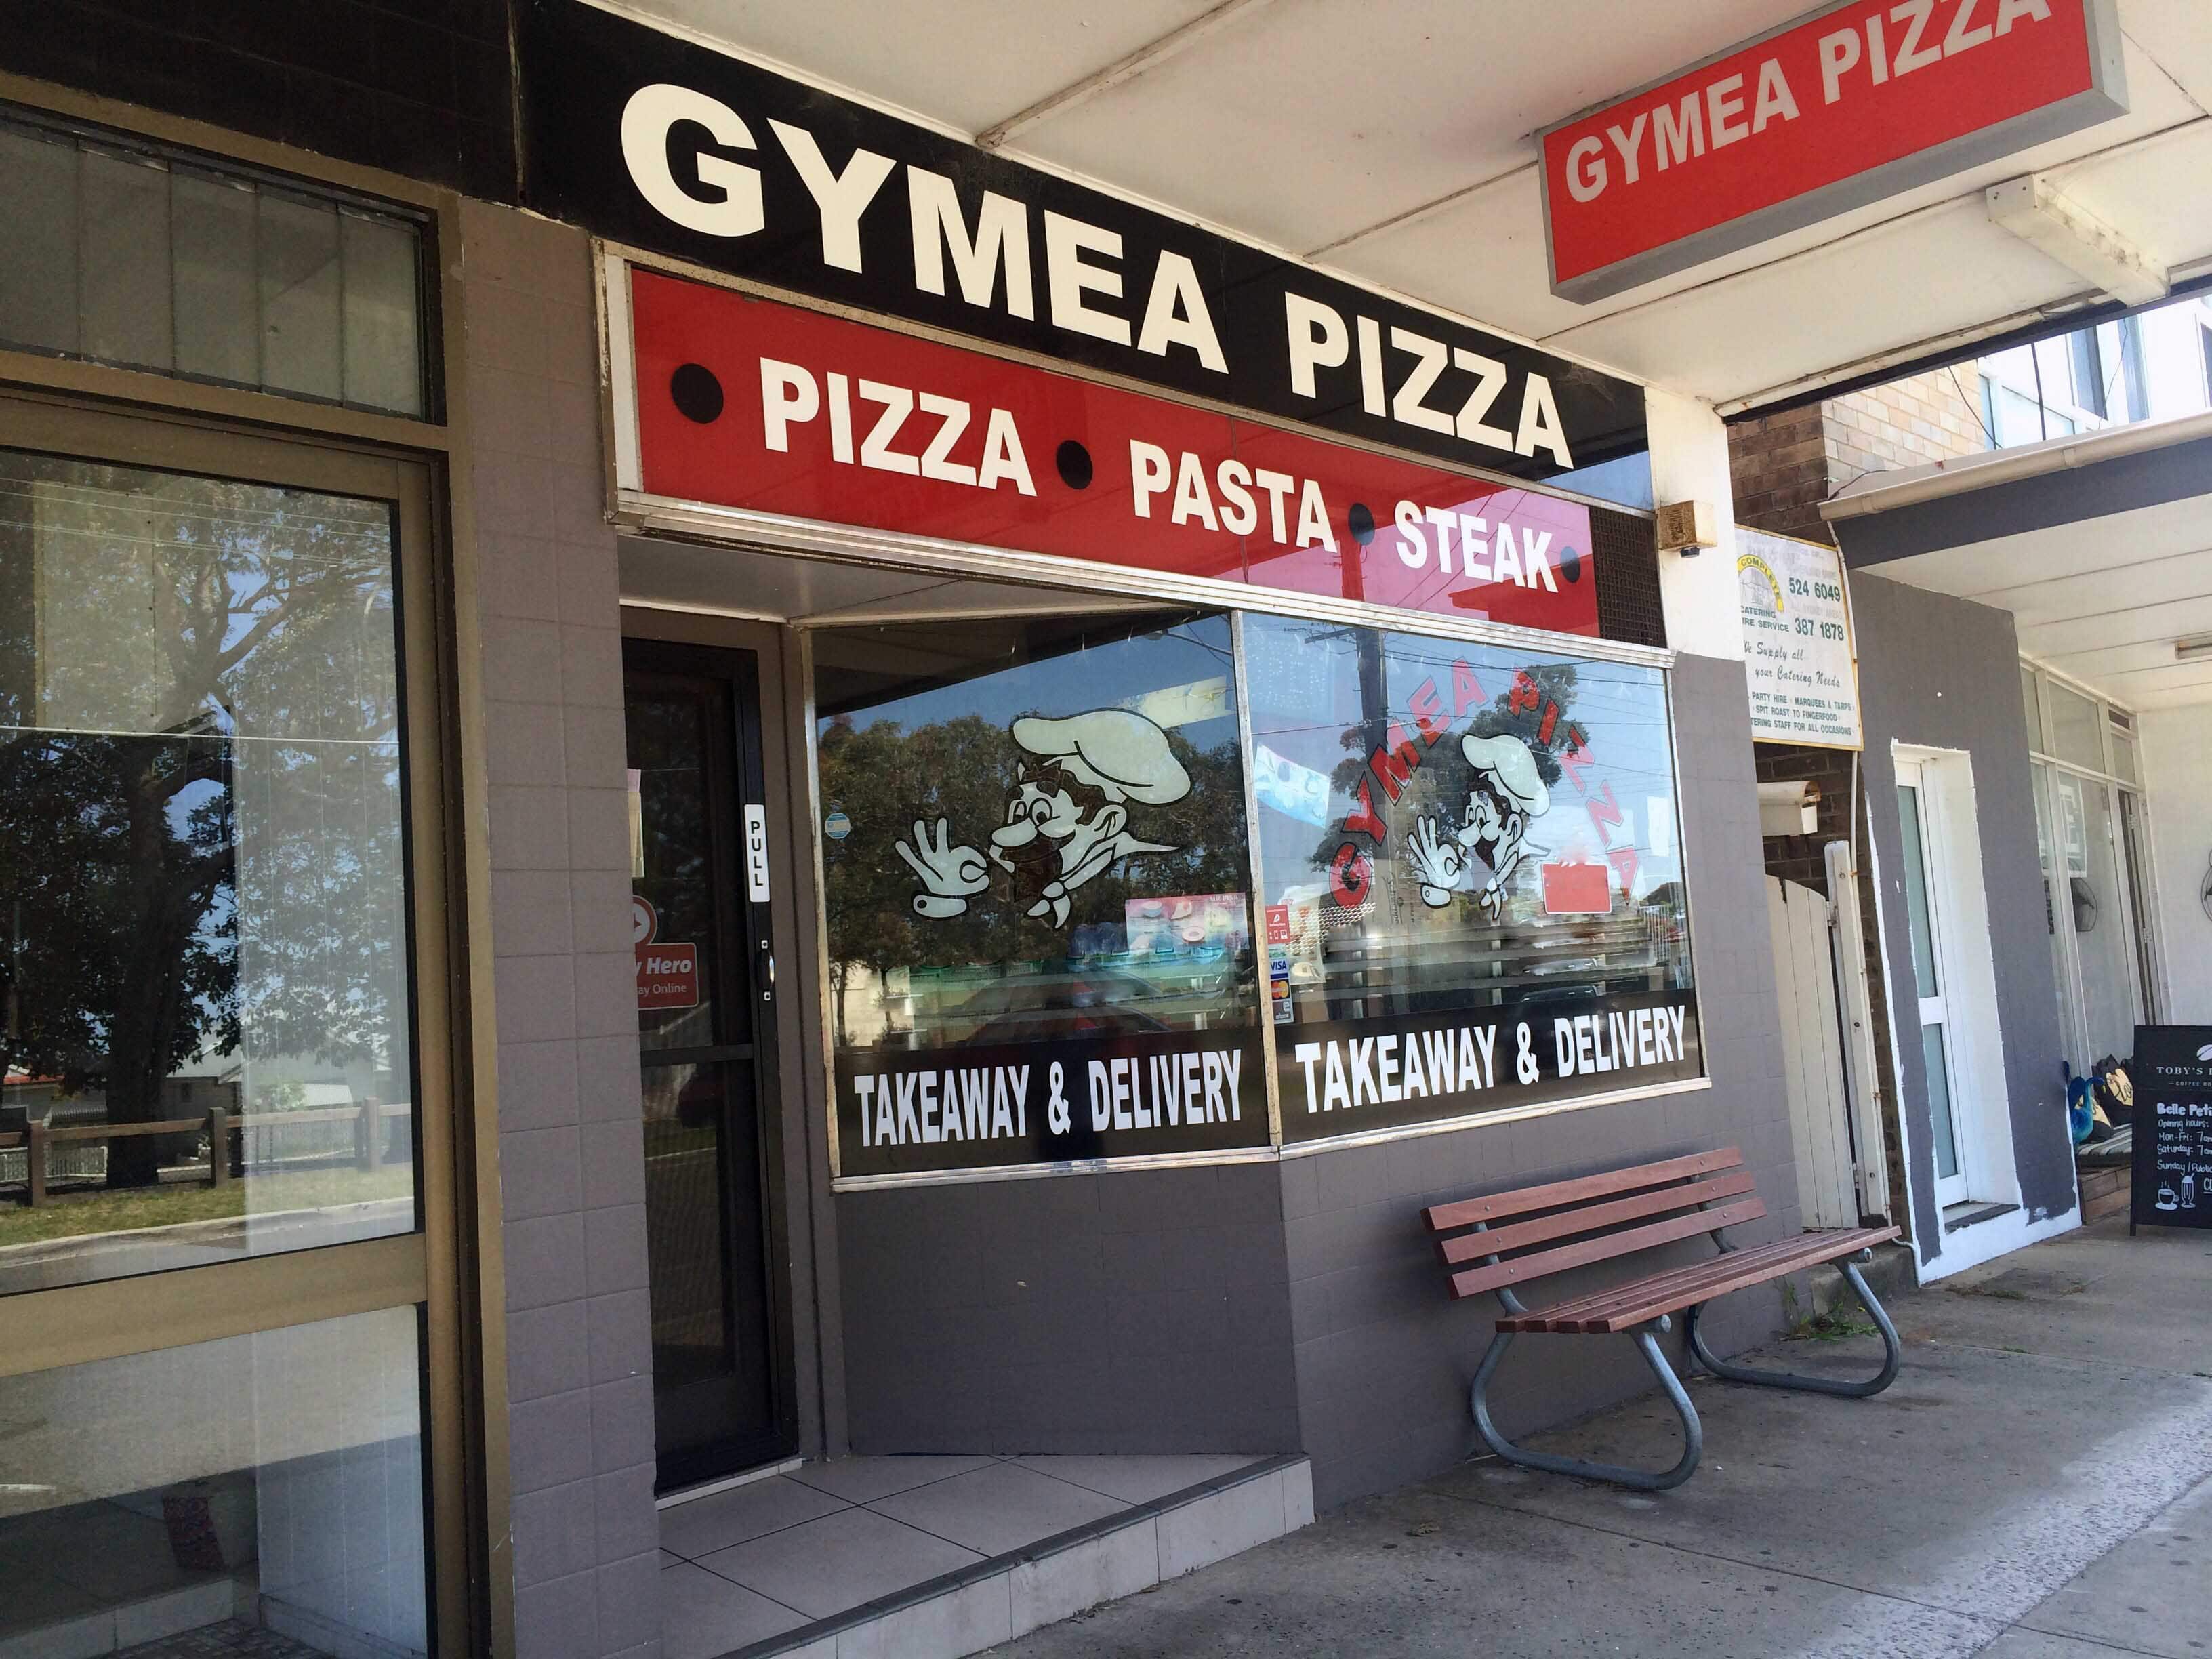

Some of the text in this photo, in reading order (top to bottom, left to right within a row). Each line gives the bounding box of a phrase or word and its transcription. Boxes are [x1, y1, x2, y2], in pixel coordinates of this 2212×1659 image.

[1565, 58, 1800, 203] GYMEA
[621, 83, 1574, 469] GYMEA PIZZA
[760, 357, 1558, 592] PIZZA PASTA STEAK
[1789, 577, 1840, 602] 524 6049
[1742, 617, 1789, 632] IRE SERVICE
[1795, 618, 1844, 641] 387 1878
[1757, 642, 1787, 661] Supply
[1792, 649, 1803, 661] all
[1755, 665, 1840, 687] your Catering Needs
[1752, 691, 1771, 702] PARTY
[1774, 694, 1787, 704] HIRE
[1795, 697, 1825, 709] MARQUEES
[1834, 701, 1851, 711] TARPS
[1755, 705, 1837, 722] SPIT ROAST TO FINGERFOOD
[1751, 717, 1851, 736] TERING STAFF FOR ALL OCCASIONS
[1329, 657, 1642, 909] GYMEA PIZZA
[751, 821, 763, 887] PULL
[646, 957, 692, 975] Hero
[1271, 960, 1287, 971] VISA
[653, 983, 687, 994] Online
[1295, 1005, 1685, 1114] TAKEAWAY & DELIVERY
[2156, 1067, 2203, 1075] TOBY'S
[855, 1049, 1242, 1147] TAKEAWAY & DELIVERY
[2157, 1103, 2186, 1115] Belle
[2158, 1119, 2209, 1132] Opening hours:
[2157, 1143, 2194, 1156] Saturday:
[2157, 1159, 2185, 1176] Sunday
